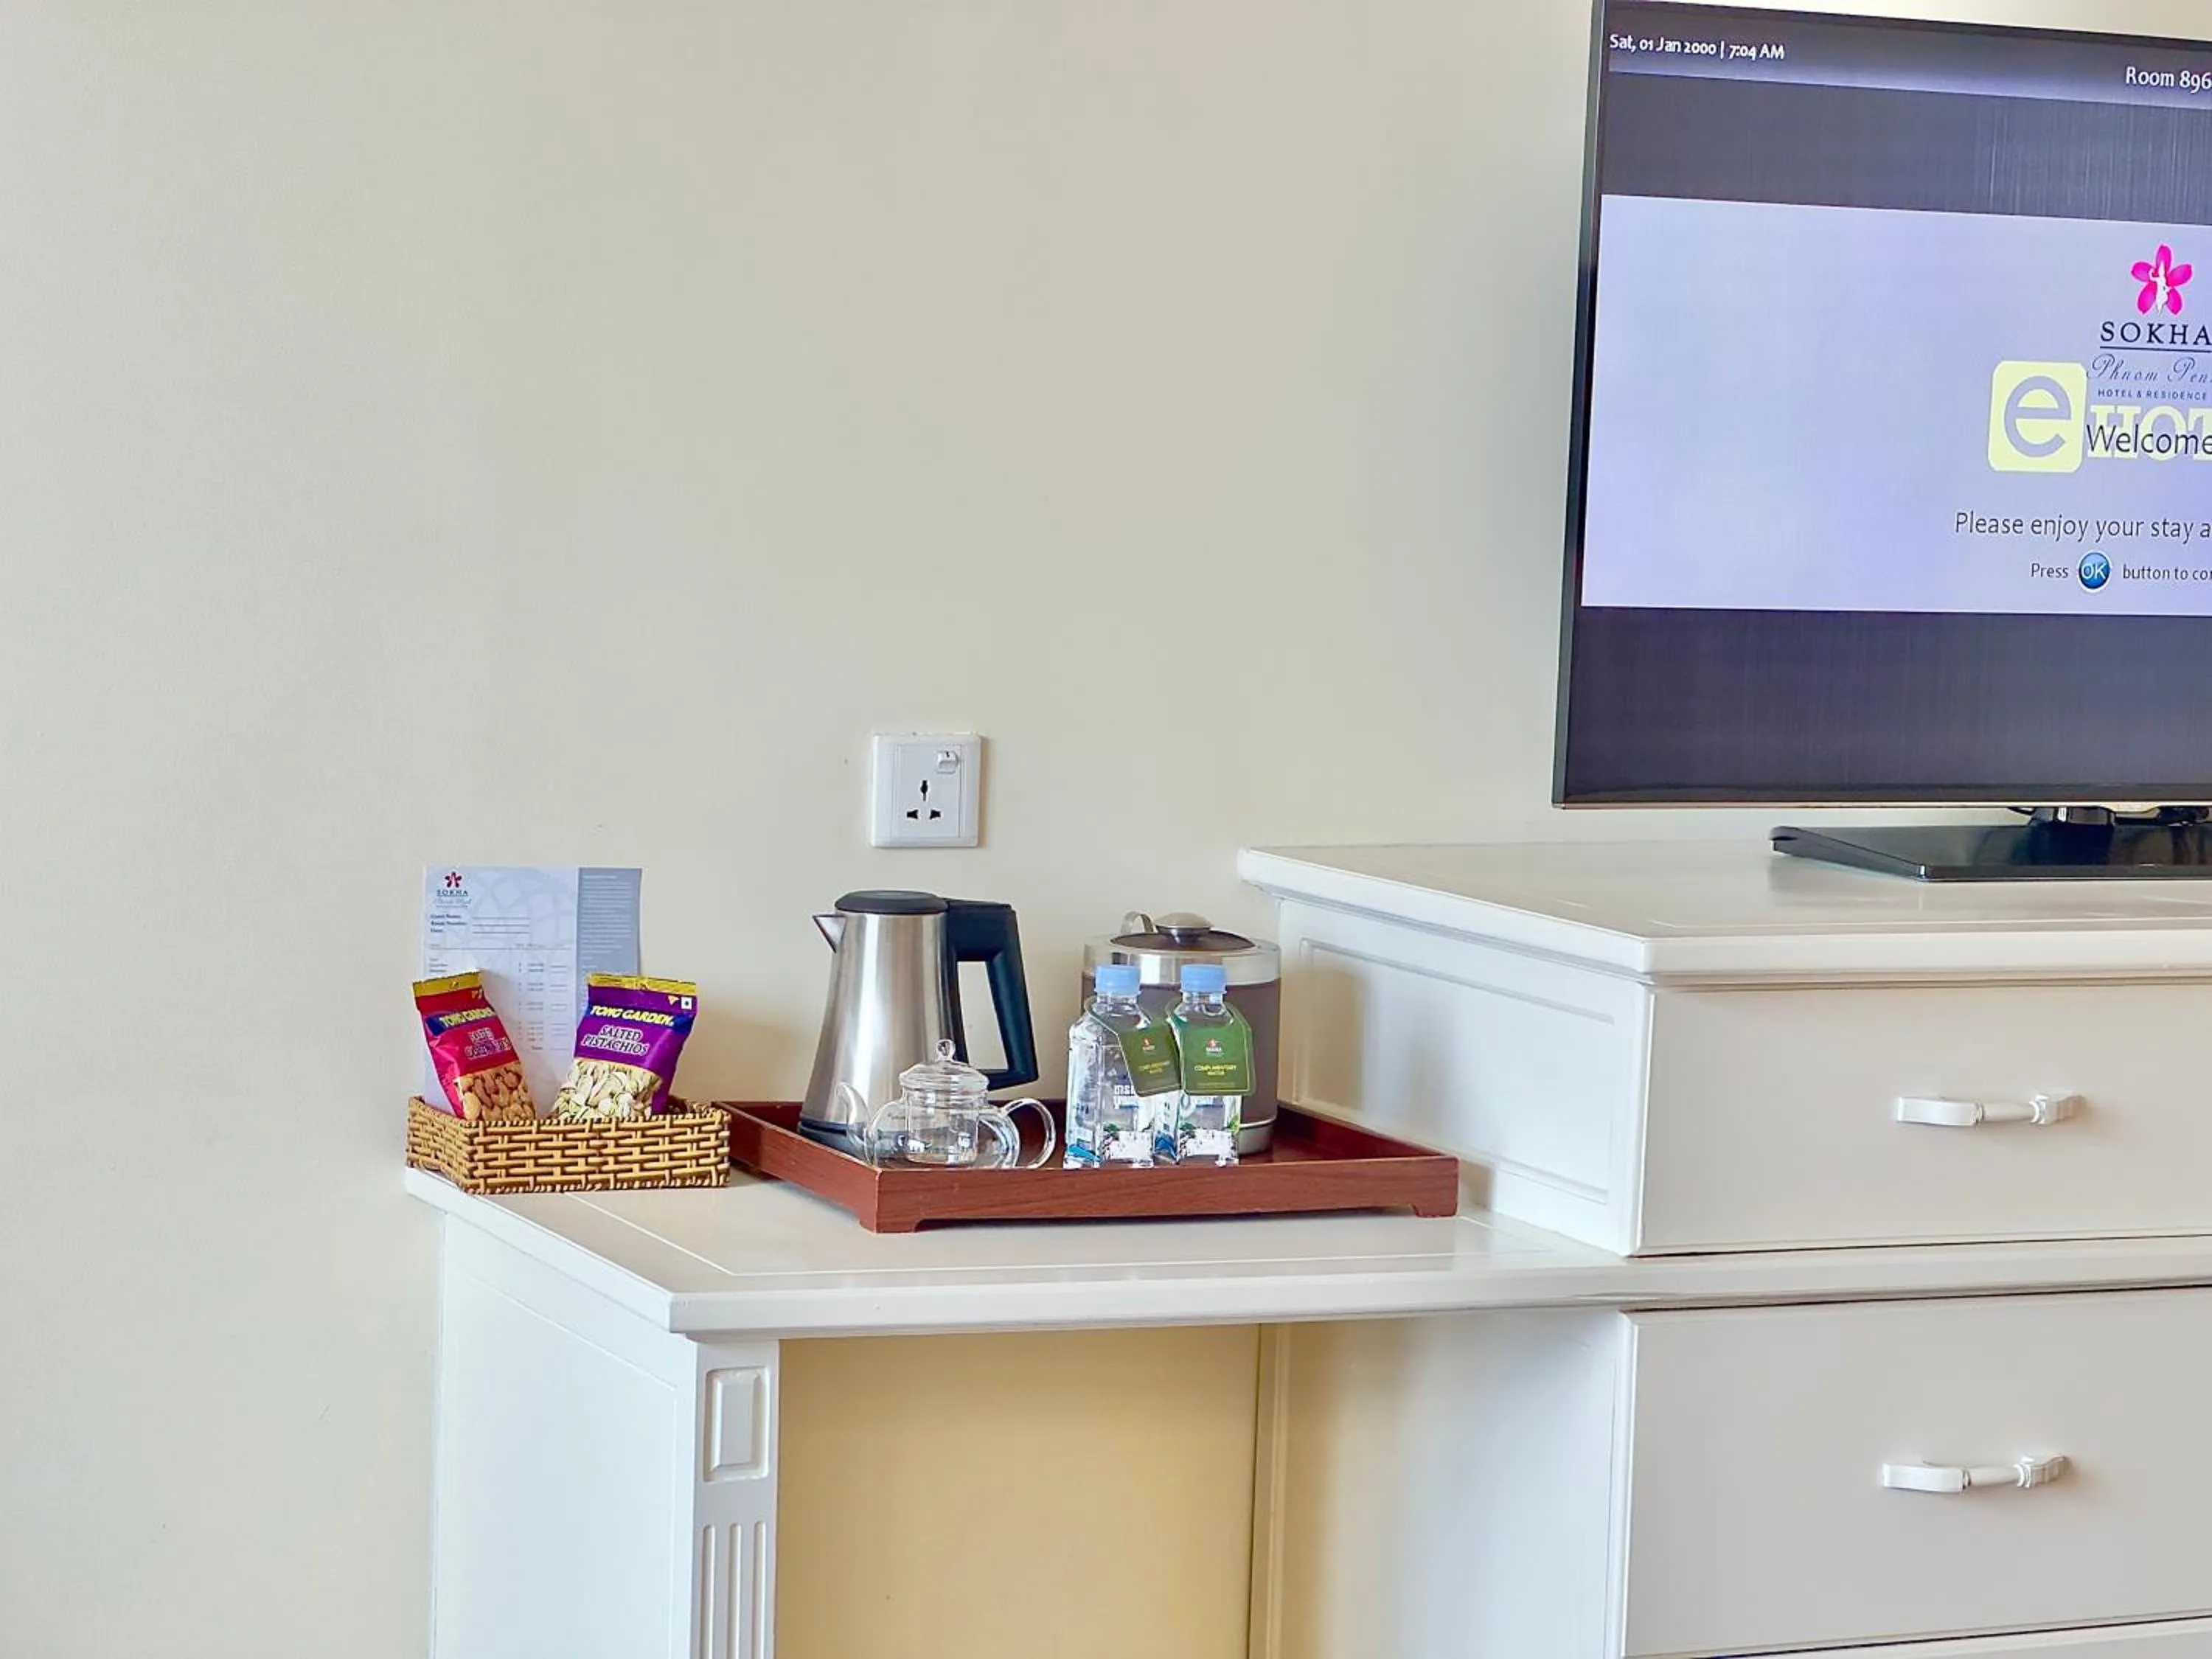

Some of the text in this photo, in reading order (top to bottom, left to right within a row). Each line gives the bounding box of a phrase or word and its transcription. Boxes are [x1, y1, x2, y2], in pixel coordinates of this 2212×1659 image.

[1610, 34, 1635, 52] Sat,
[1639, 38, 1653, 51] 01
[1656, 37, 1681, 52] Jan
[1683, 42, 1717, 55] 2000
[1729, 45, 1756, 60] 7:04
[1759, 44, 1785, 60] AM
[2126, 66, 2212, 94] Room 896
[2100, 321, 2212, 346] SOKHA
[2086, 353, 2212, 383] Phnom Pen
[2098, 389, 2132, 398] HOTEL
[2146, 390, 2207, 400] RESIDENCE
[2087, 424, 2212, 455] Welcome
[1955, 510, 2024, 535] Please
[2031, 514, 2089, 542] enjoy
[2096, 518, 2144, 543] your
[2151, 518, 2194, 544] stay
[2031, 563, 2212, 581] Press OK button to co
[590, 1005, 621, 1018] TONG
[581, 1034, 650, 1056] PISTACHIOS
[599, 1025, 643, 1041] SALTED
